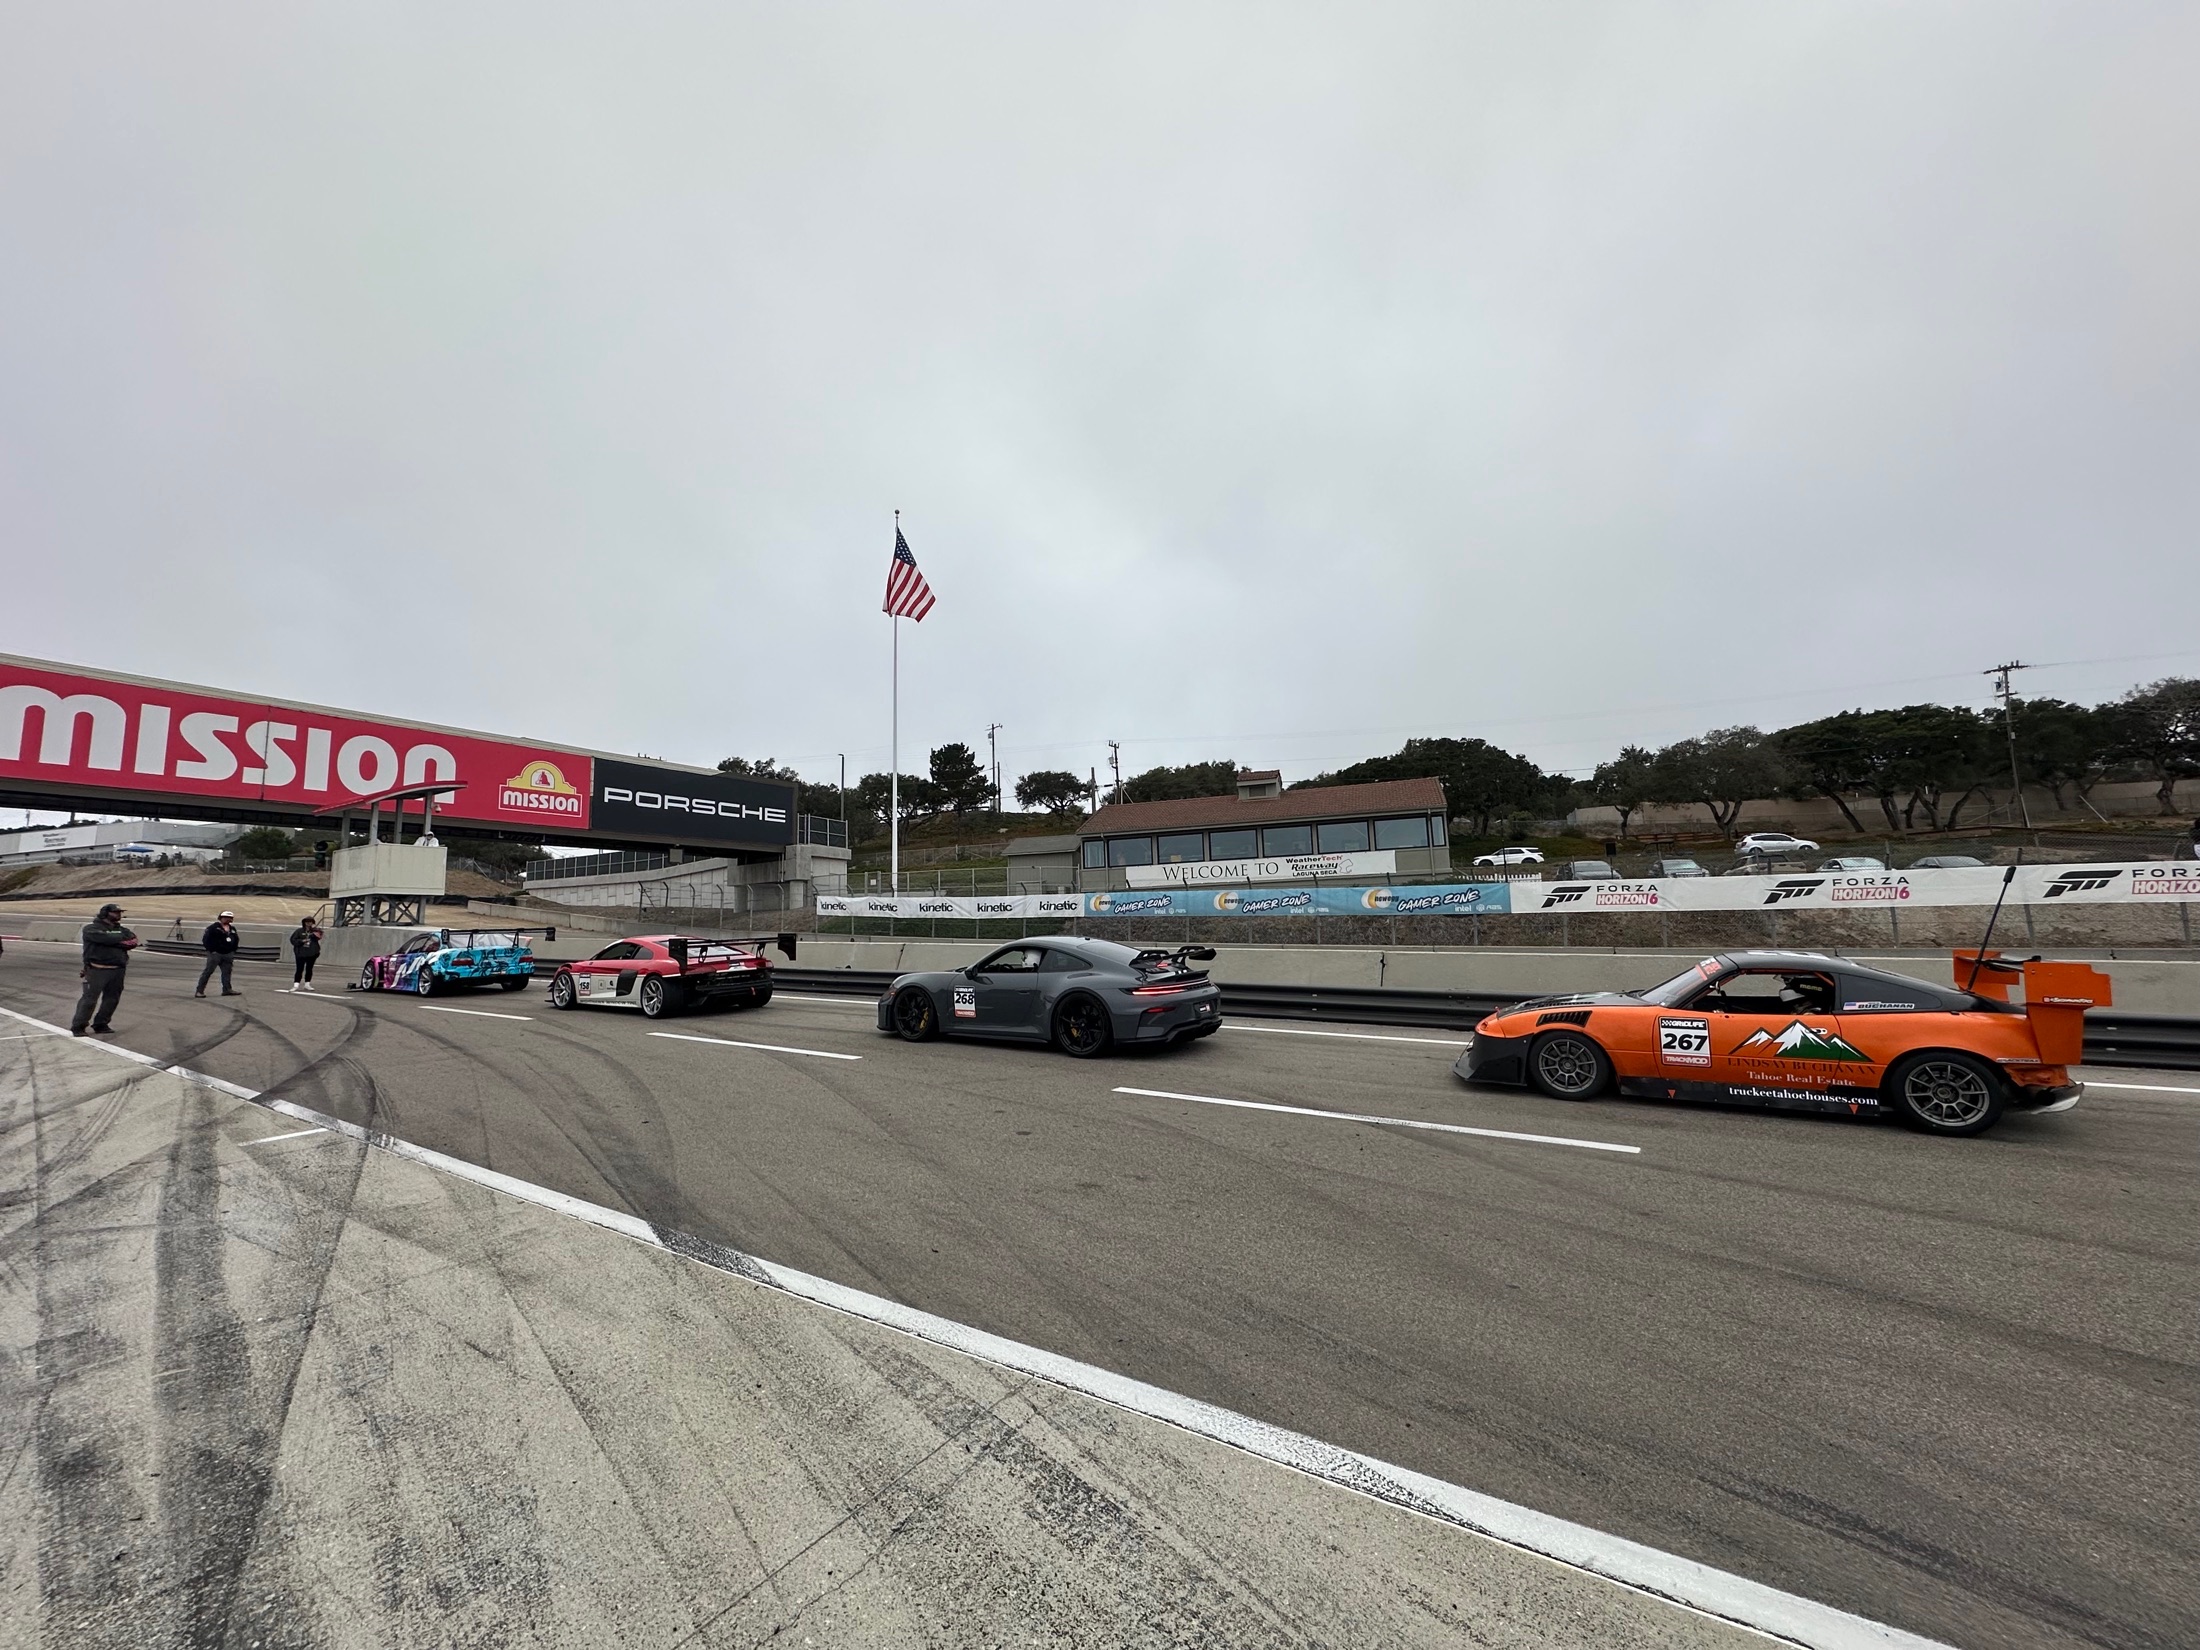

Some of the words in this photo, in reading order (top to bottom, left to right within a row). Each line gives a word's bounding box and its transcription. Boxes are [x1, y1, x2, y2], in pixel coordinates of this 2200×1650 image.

[604, 787, 786, 823] PORSCHE
[1285, 855, 1342, 864] WeatherTech
[1162, 863, 1248, 881] WELCOME
[1254, 861, 1279, 876] TO
[1291, 862, 1338, 871] Raceway
[1832, 877, 1910, 886] FORZA
[1596, 884, 1658, 892] FORZA
[1833, 887, 1896, 900] HORIZON
[1899, 886, 1910, 899] 6
[1114, 901, 1145, 914] GAMER
[1146, 895, 1171, 908] ZONE
[1242, 898, 1280, 913] GAMER
[1280, 892, 1311, 907] ZONE
[1397, 895, 1442, 912] GAMER
[1443, 888, 1482, 904] ZONE
[1597, 894, 1648, 905] HORIZON
[1649, 893, 1658, 905] 6
[820, 901, 847, 911] kinetic
[868, 902, 898, 912] kinetic
[919, 902, 953, 912] kinetic
[977, 902, 1013, 912] kinetic
[1039, 900, 1078, 911] kinetic
[1455, 904, 1472, 912] intel
[955, 991, 974, 1004] 268
[1672, 1020, 1705, 1028] GRIDLIFE
[1663, 1033, 1708, 1051] 267
[1727, 1057, 1786, 1069] LINDSAY
[1792, 1061, 1876, 1075] BUCHANAN
[1747, 1071, 1783, 1081] Tahoe
[1786, 1073, 1813, 1083] Real
[1817, 1075, 1856, 1087] Estate
[1729, 1086, 1878, 1106] truckeetahoehouses.com
